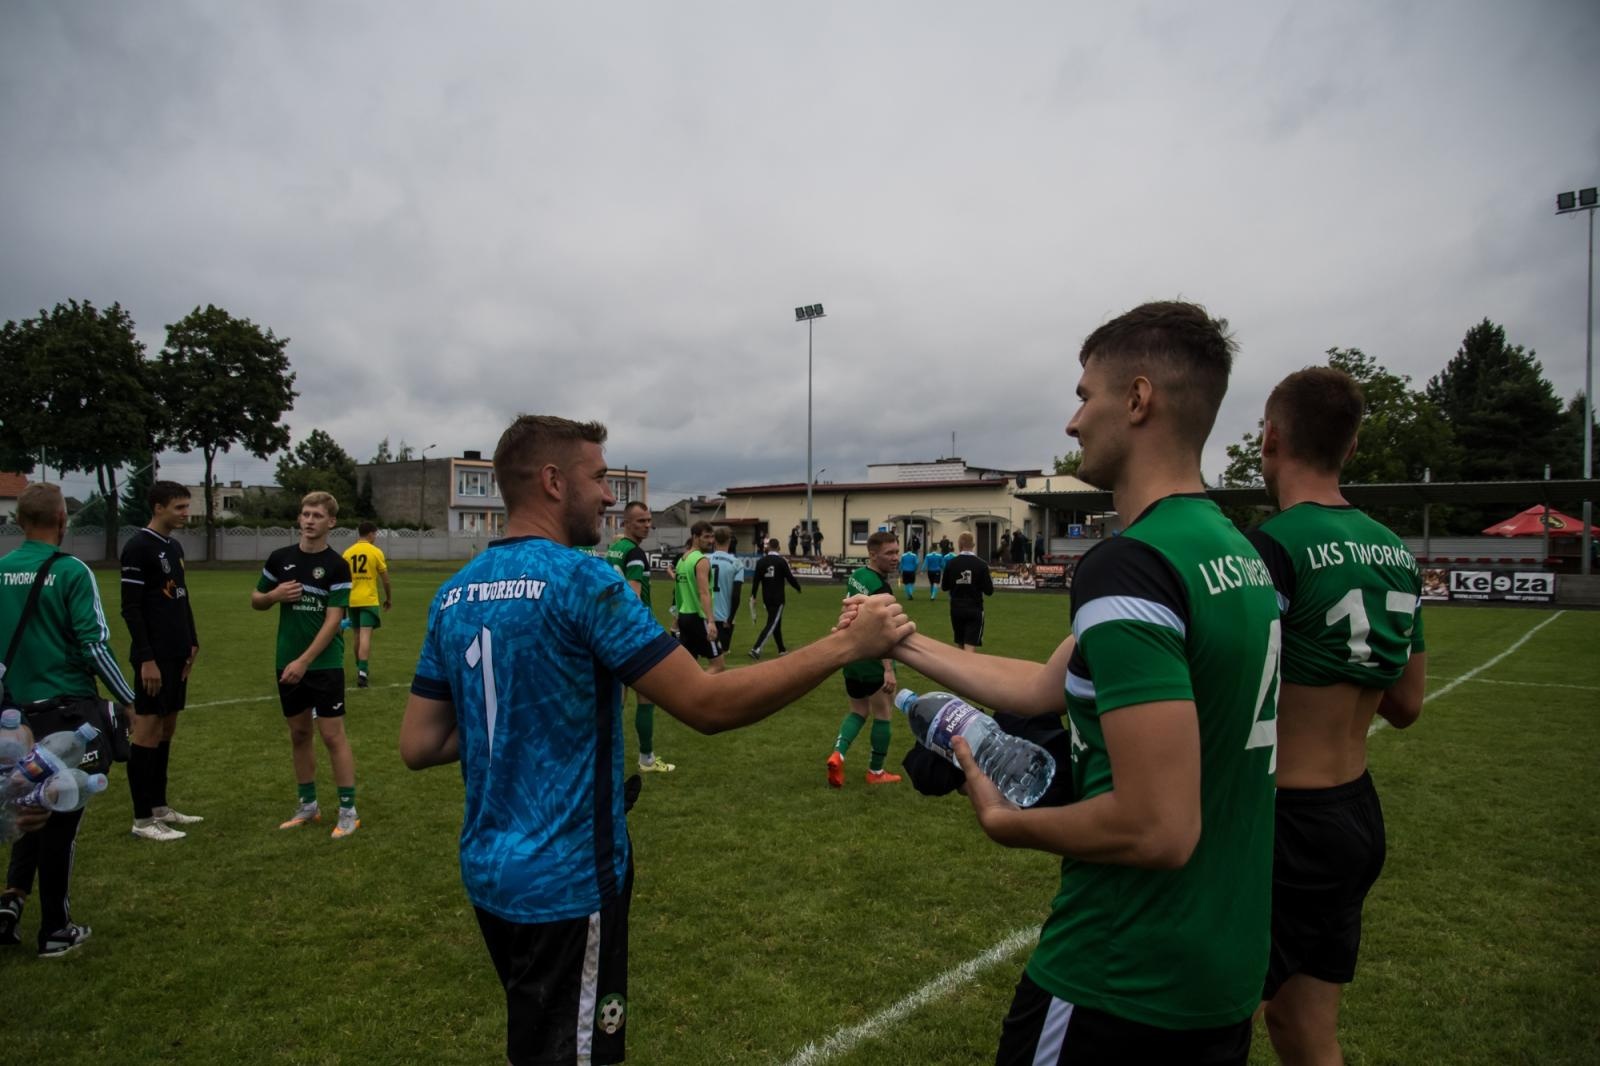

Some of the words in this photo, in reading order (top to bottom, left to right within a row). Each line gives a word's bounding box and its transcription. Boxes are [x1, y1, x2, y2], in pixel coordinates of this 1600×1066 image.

[351, 554, 367, 573] 12
[1307, 542, 1345, 569] LKS
[4, 572, 57, 587] TWORKW
[466, 573, 548, 602] TWORKÓW
[712, 564, 720, 592] 1
[1198, 555, 1243, 595] LKS
[464, 623, 498, 768] 1
[1244, 618, 1282, 775] 4
